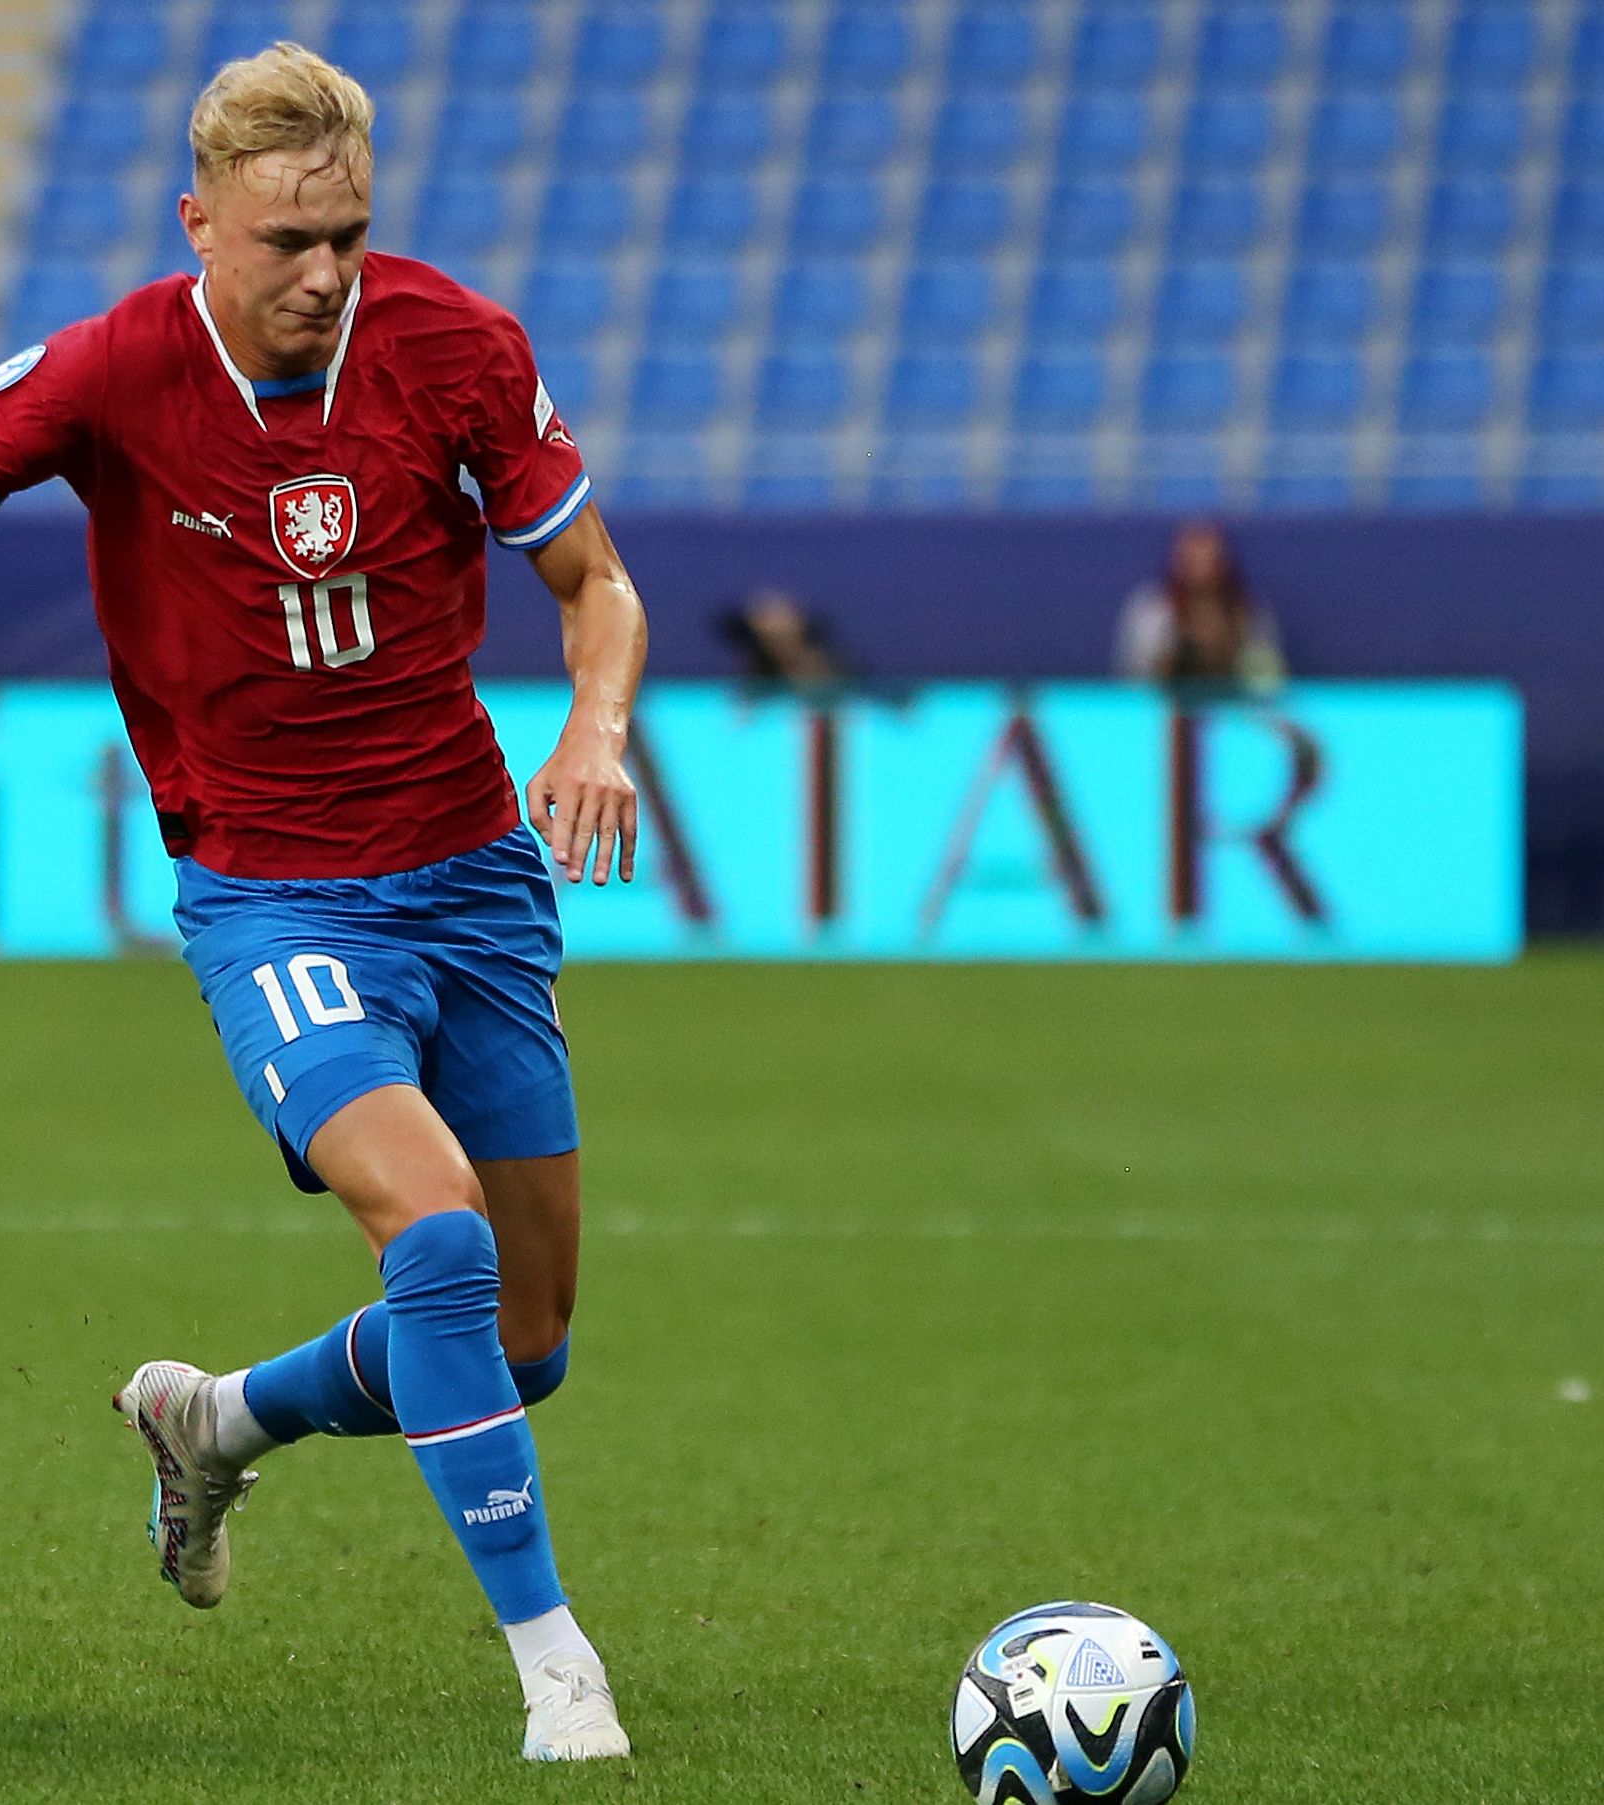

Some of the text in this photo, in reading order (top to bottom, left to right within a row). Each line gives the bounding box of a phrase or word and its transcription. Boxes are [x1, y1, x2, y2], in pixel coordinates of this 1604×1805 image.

[278, 572, 375, 672] 10
[252, 953, 366, 1043] 10
[463, 1499, 526, 1526] PUMA
